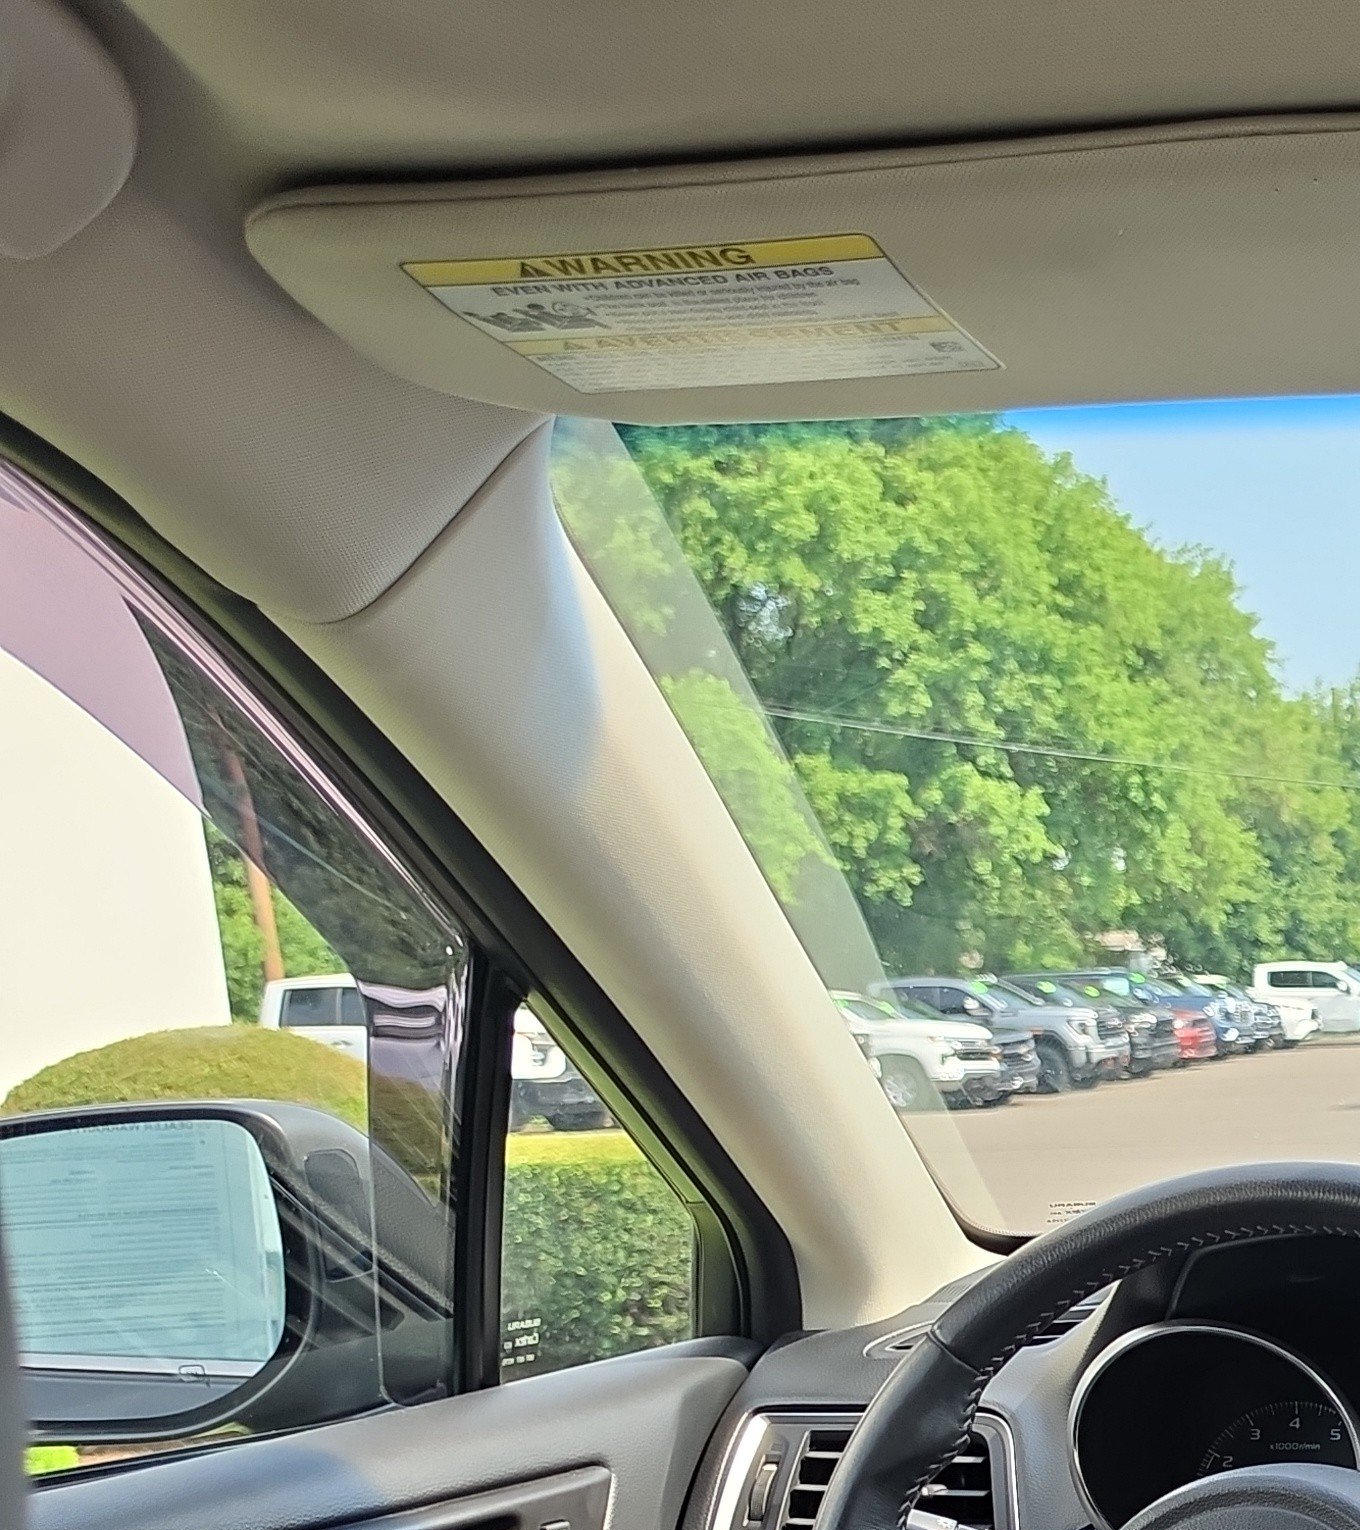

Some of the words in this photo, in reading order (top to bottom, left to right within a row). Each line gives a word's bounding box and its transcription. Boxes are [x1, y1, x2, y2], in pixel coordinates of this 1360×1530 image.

[546, 247, 756, 276] WARNING
[493, 284, 551, 297] EVEN
[554, 282, 608, 294] WITH
[614, 274, 729, 289] ADVANCED
[736, 270, 769, 283] AIR
[775, 267, 835, 280] BAGS
[1289, 1417, 1301, 1429] 4
[1250, 1428, 1261, 1440] 3
[1330, 1428, 1341, 1441] 5
[1222, 1455, 1234, 1467] 2
